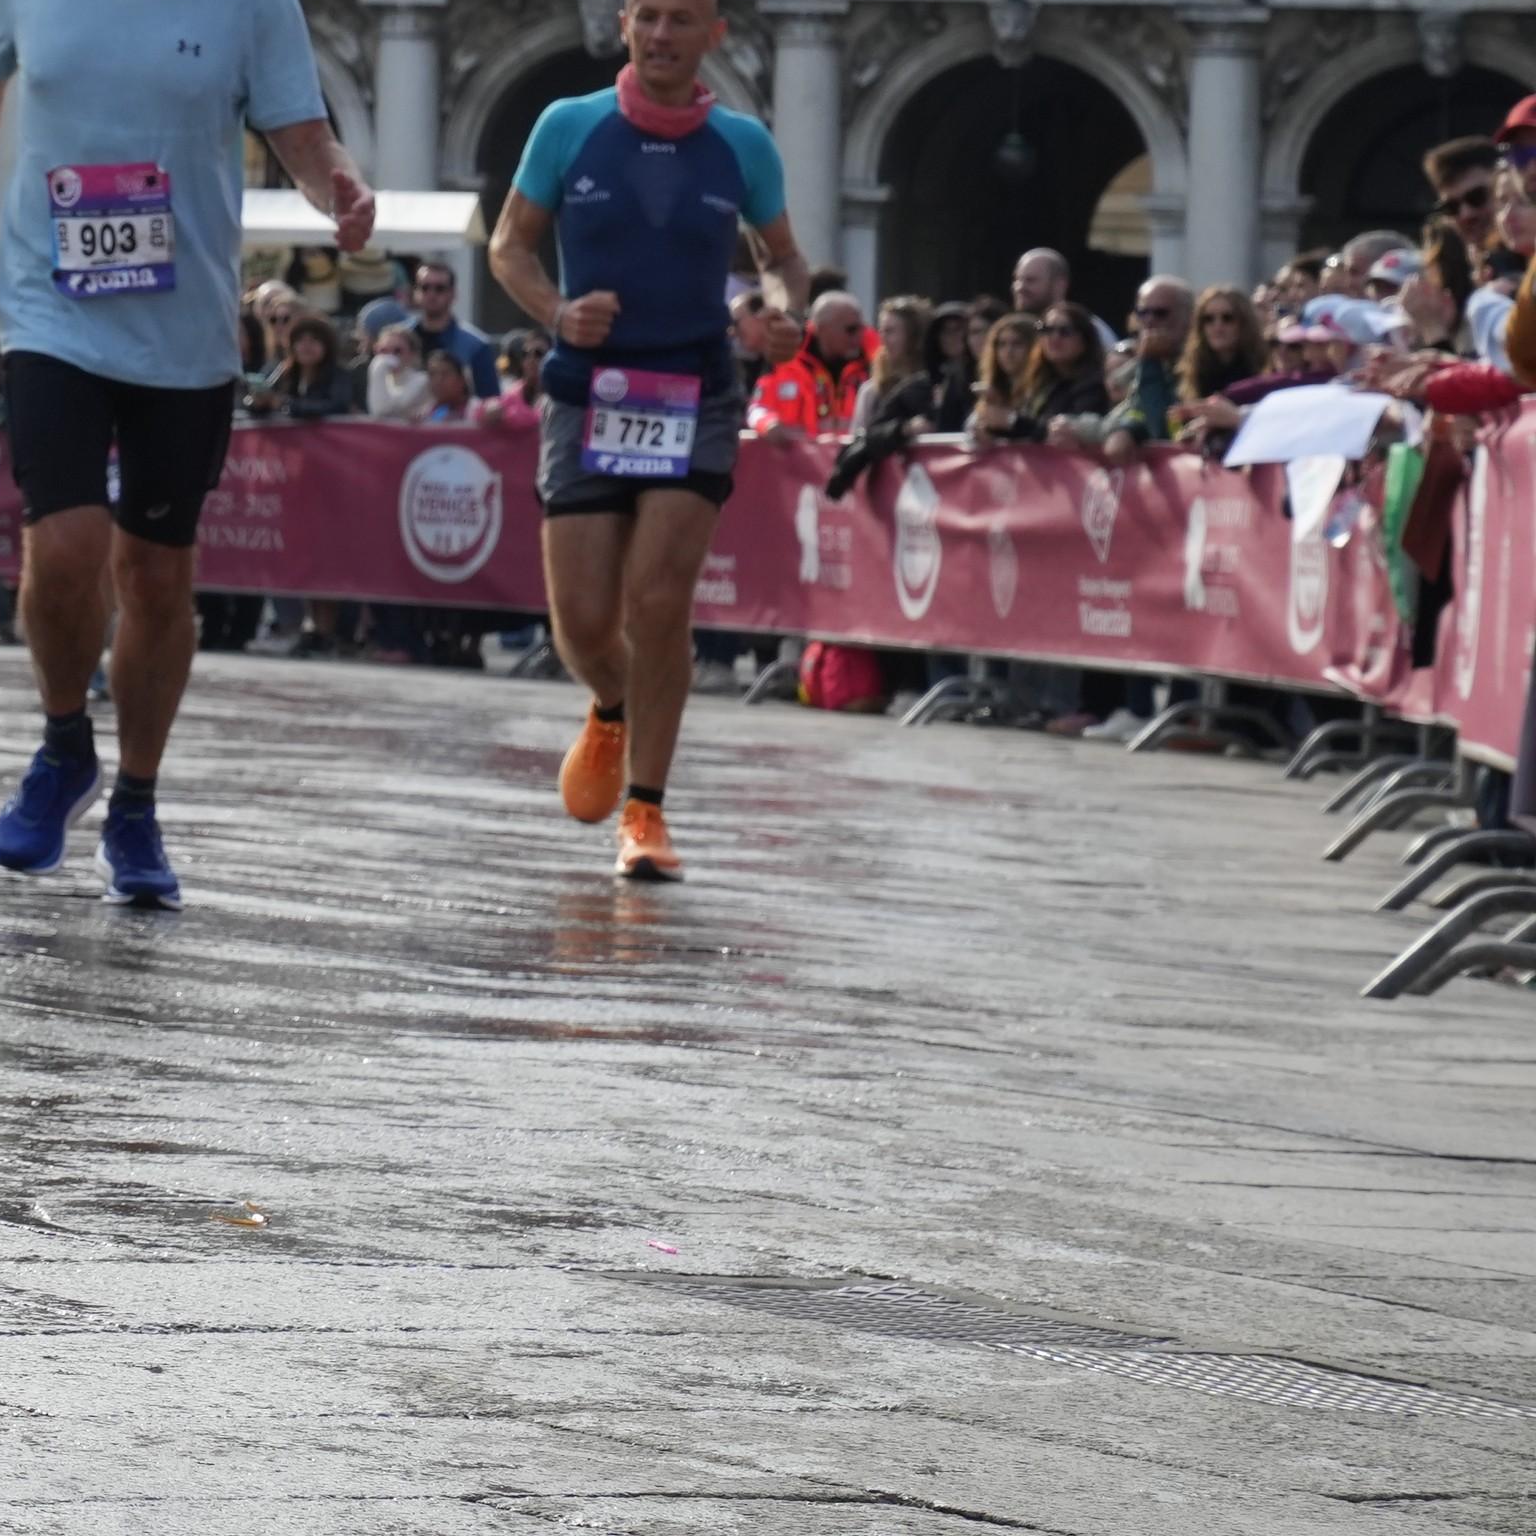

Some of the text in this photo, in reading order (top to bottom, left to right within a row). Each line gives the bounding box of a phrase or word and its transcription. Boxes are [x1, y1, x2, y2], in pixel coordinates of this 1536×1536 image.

[80, 222, 137, 257] 903
[619, 416, 665, 446] 772
[416, 496, 478, 514] VENICE
